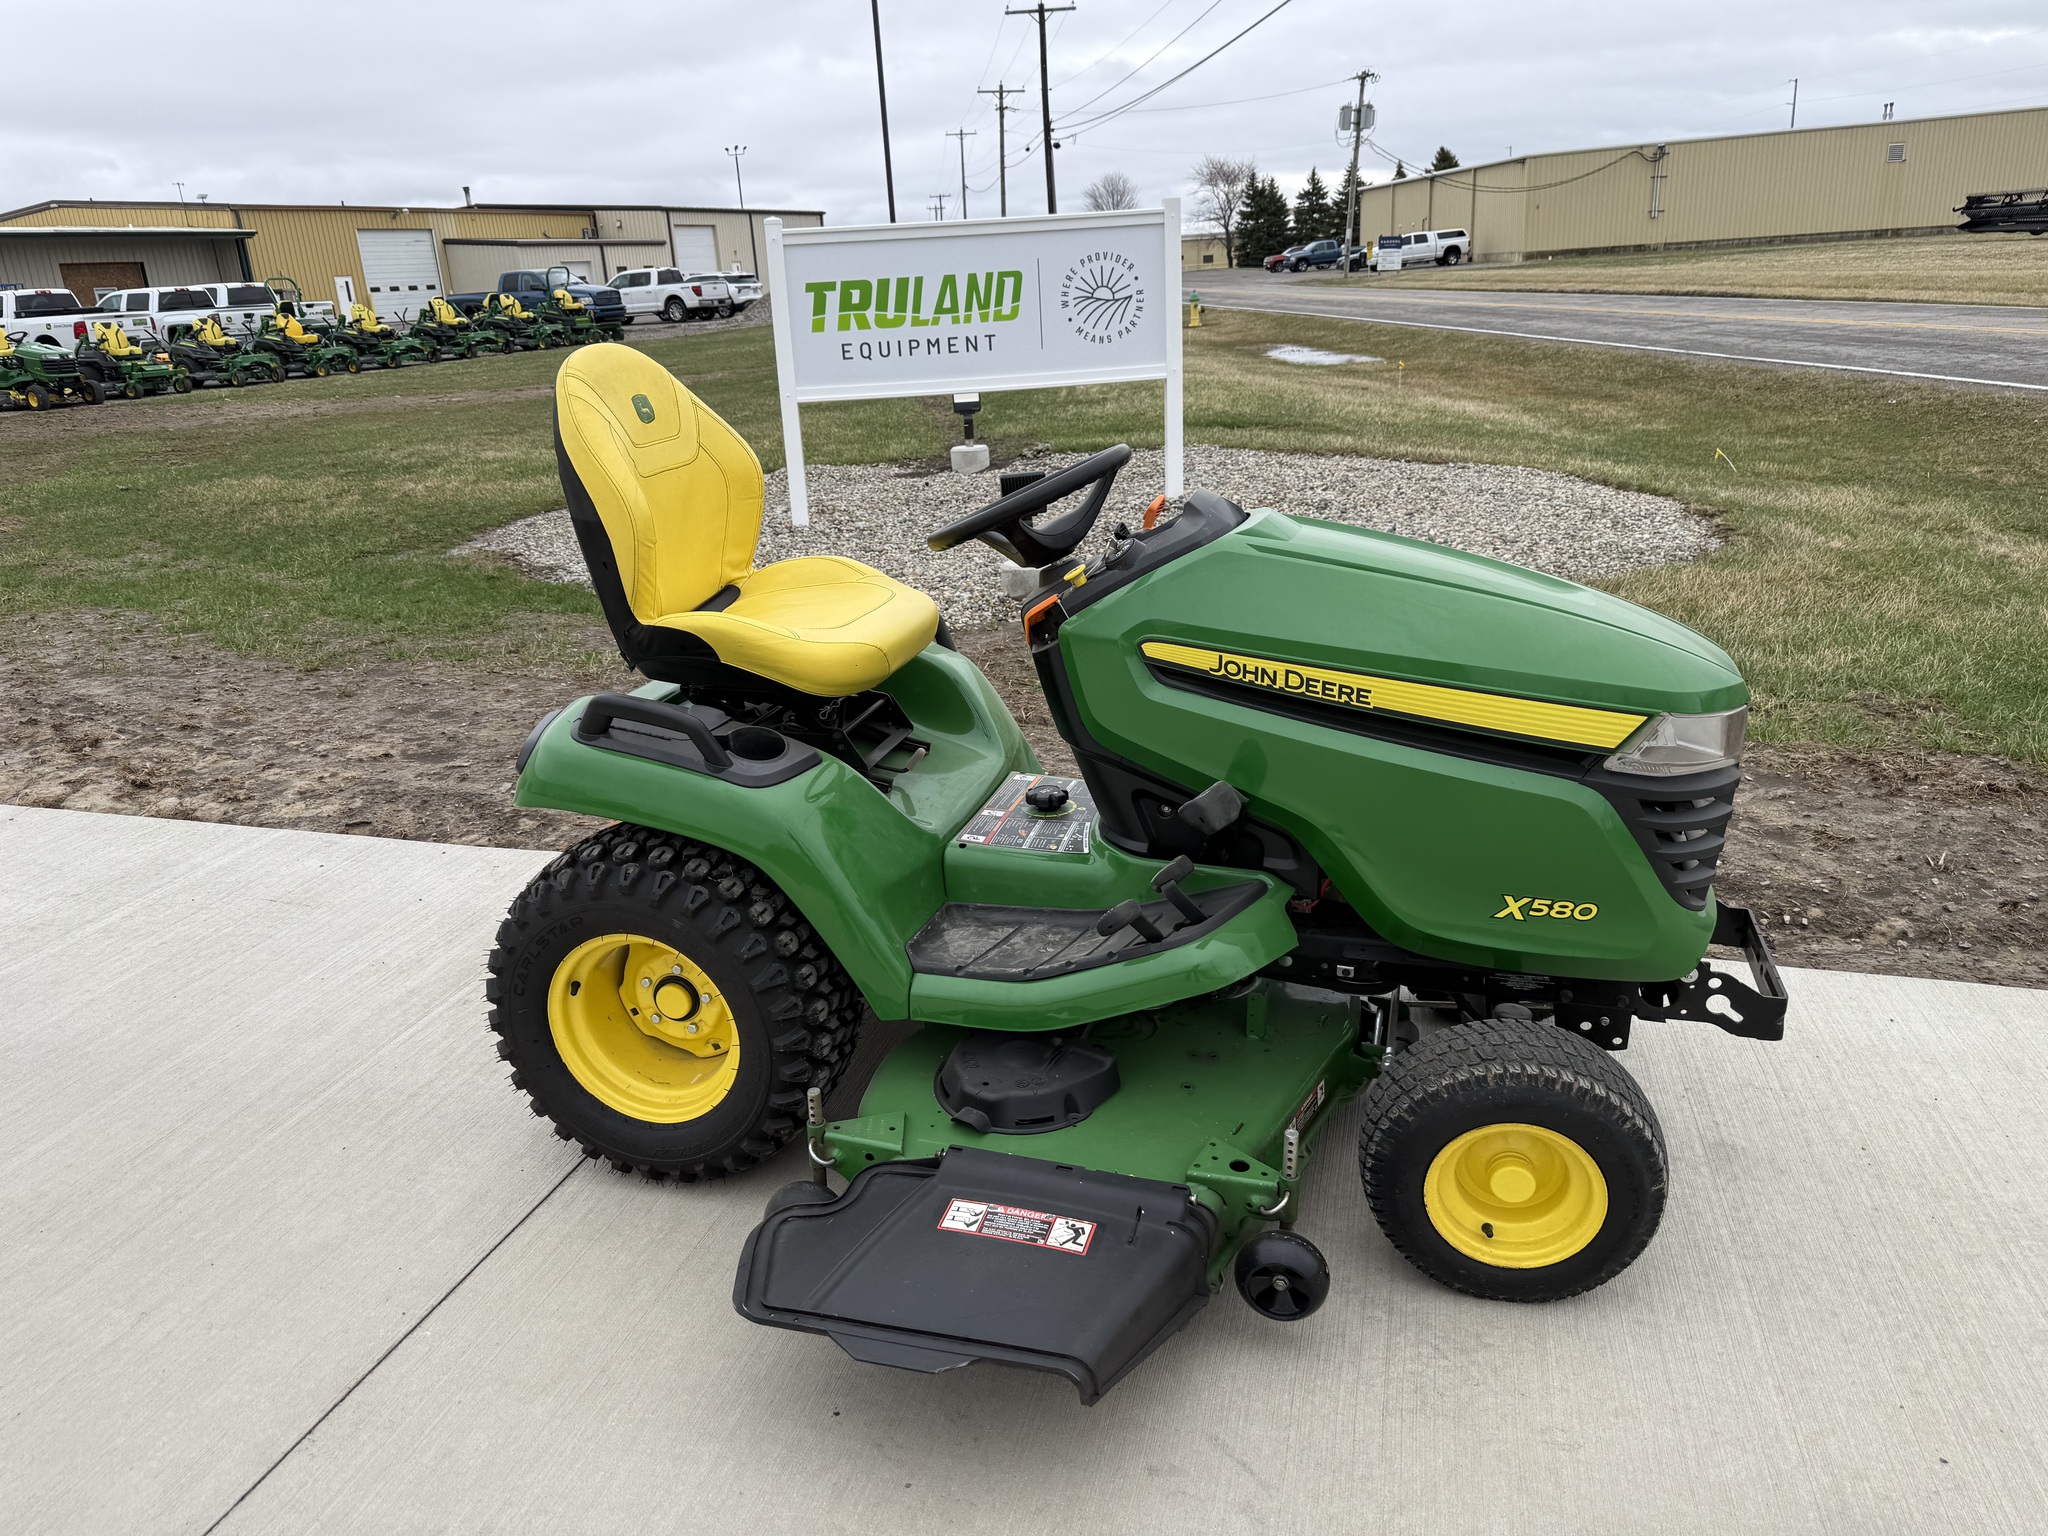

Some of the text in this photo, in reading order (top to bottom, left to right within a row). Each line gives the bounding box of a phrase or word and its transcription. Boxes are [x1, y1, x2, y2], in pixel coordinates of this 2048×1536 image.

[804, 269, 1024, 334] TRULAND
[1060, 251, 1135, 309] WHERE PROVIDER
[1074, 288, 1145, 345] MEANS PARTNER
[841, 334, 997, 361] EQUIPMENT
[1208, 654, 1374, 708] JOHN DEERE
[1490, 893, 1600, 922] X580
[513, 916, 584, 997] CARLSTAR
[1006, 1207, 1047, 1220] DANGER
